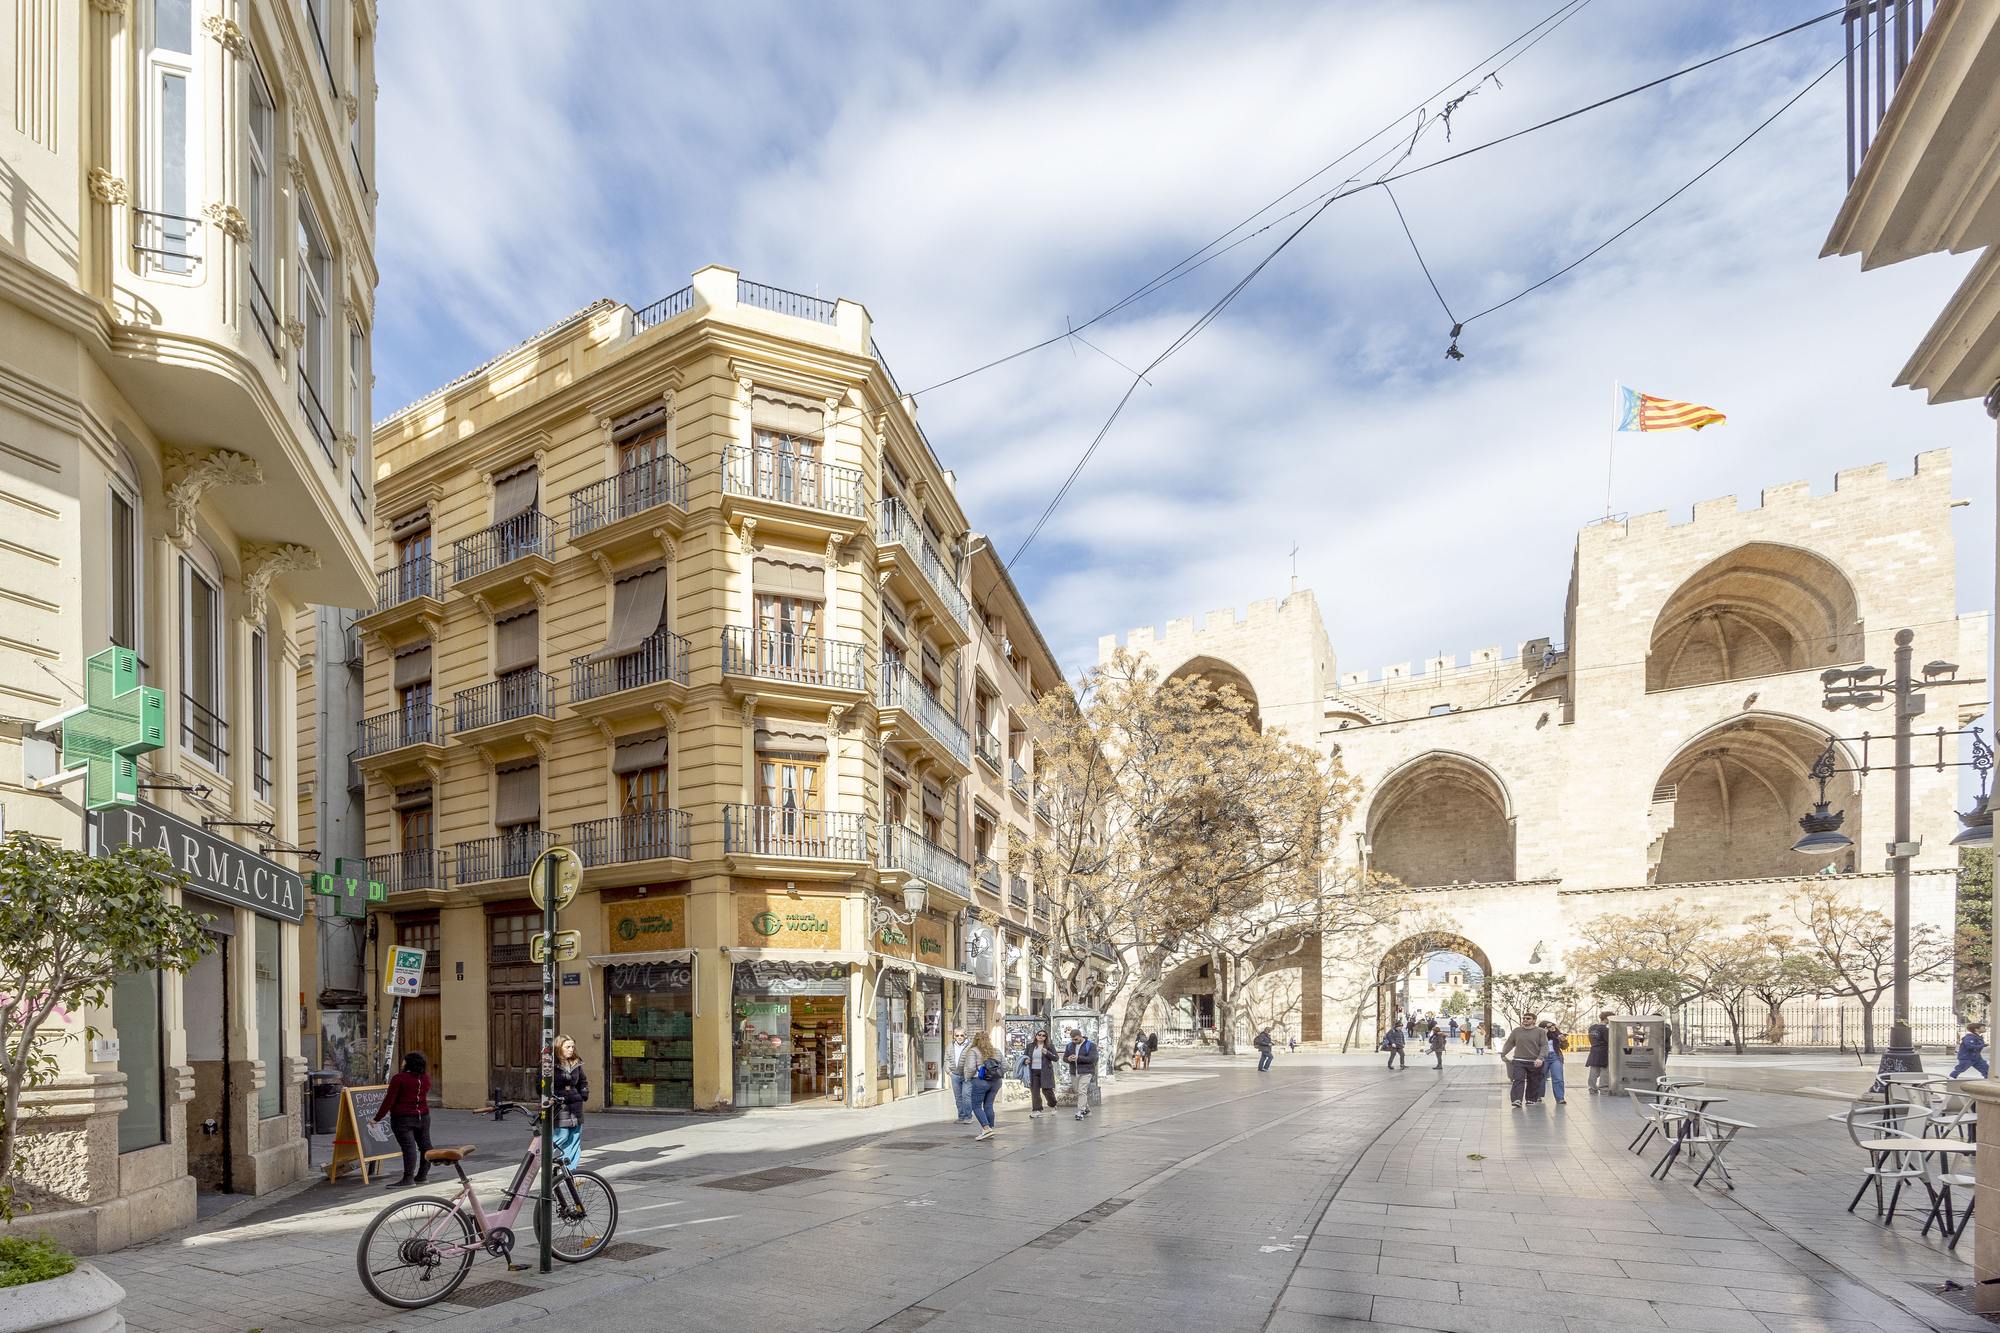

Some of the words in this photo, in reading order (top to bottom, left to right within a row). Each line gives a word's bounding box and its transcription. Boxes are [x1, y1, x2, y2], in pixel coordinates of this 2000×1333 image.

[124, 809, 295, 911] FARMACIA
[785, 912, 816, 921] natural
[640, 919, 673, 933] world
[786, 919, 829, 933] world
